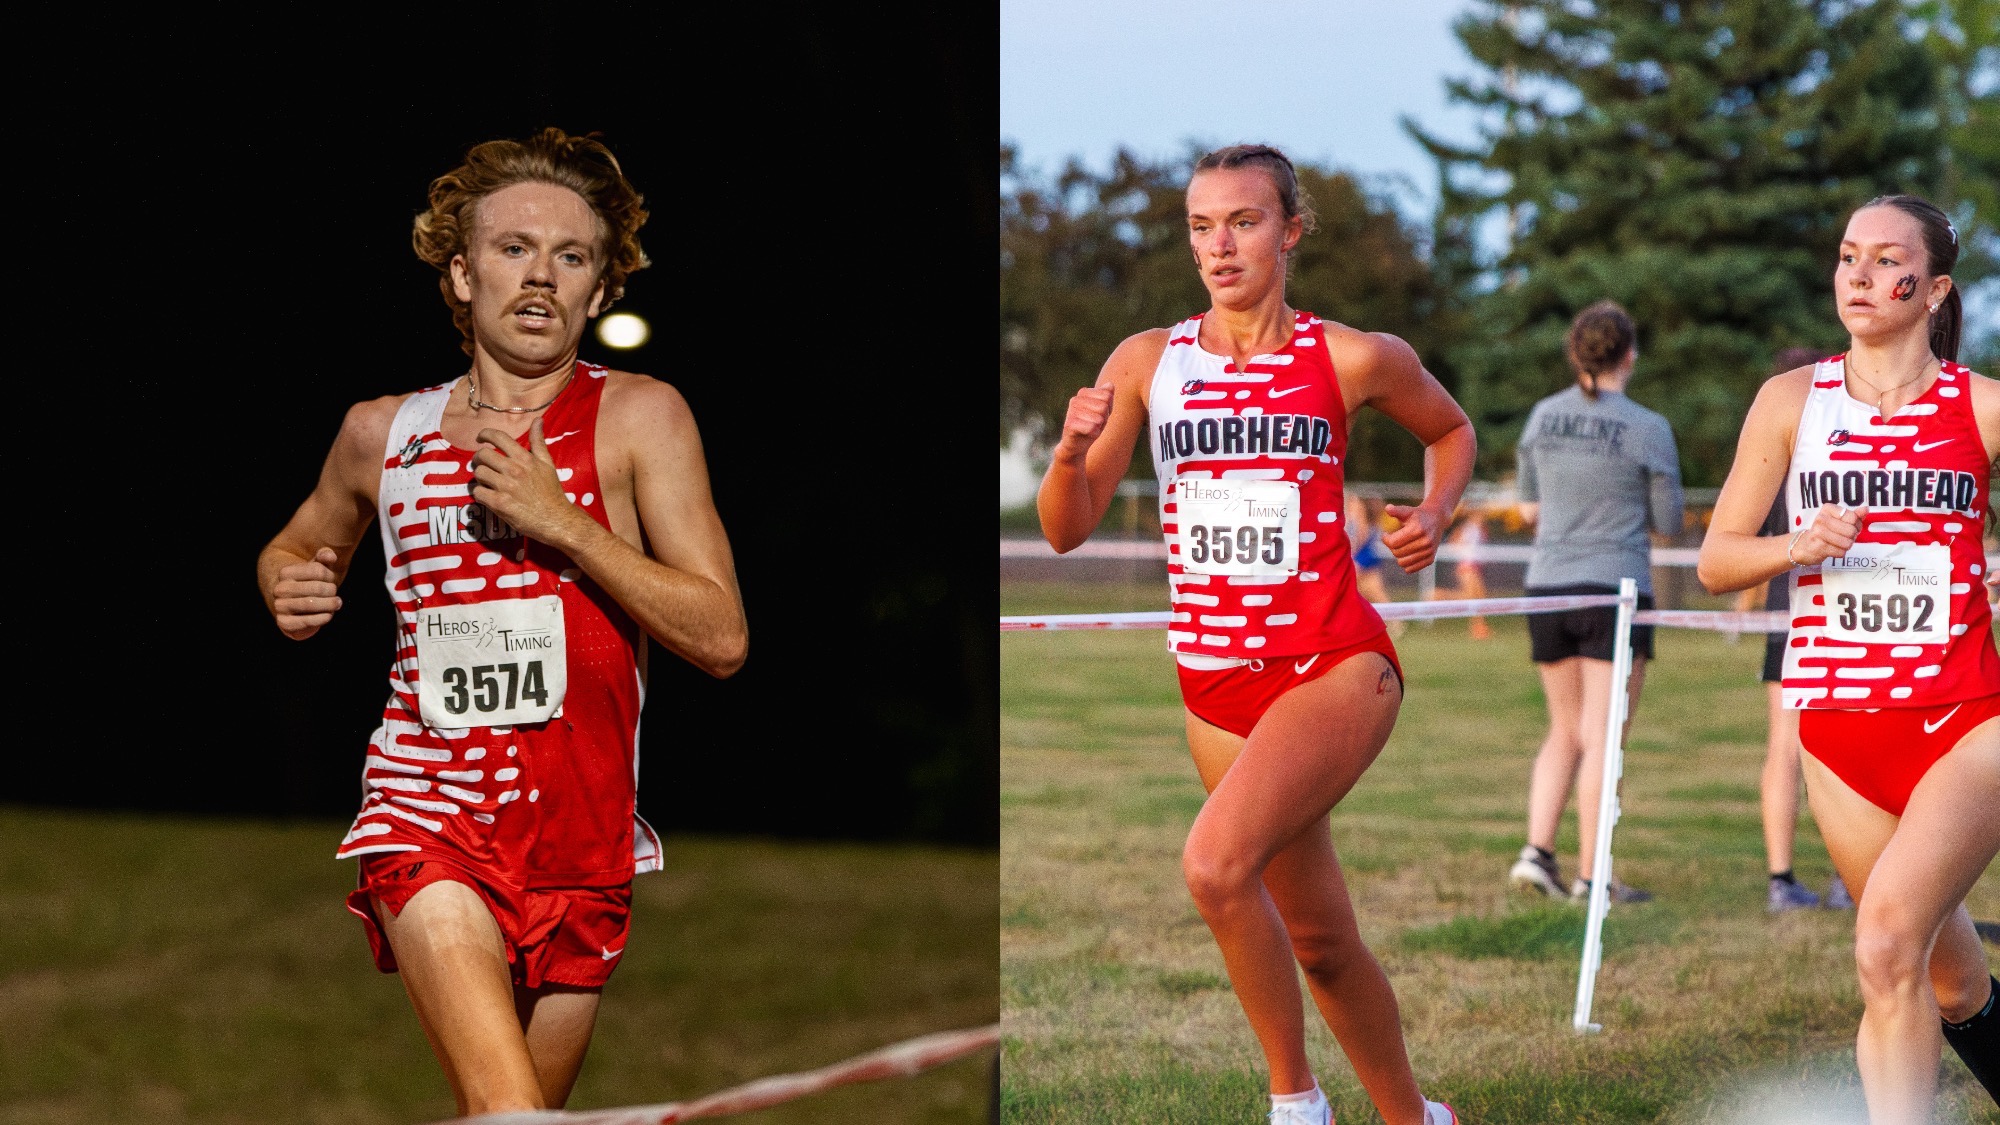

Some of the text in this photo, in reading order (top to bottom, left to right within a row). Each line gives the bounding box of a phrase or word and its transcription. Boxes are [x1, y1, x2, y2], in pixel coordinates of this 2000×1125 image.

[1158, 415, 1330, 463] MOORHEAD
[1184, 481, 1230, 500] HERO'S
[1243, 499, 1288, 518] TIMING
[1799, 469, 1976, 511] MOORHEAD
[428, 502, 525, 546] MSU
[1190, 524, 1285, 565] 3595
[1892, 567, 1938, 586] TIMING
[427, 613, 480, 637] HERO'S
[1837, 592, 1935, 633] 3592
[497, 629, 552, 652] TIMING
[442, 660, 549, 715] 3574
